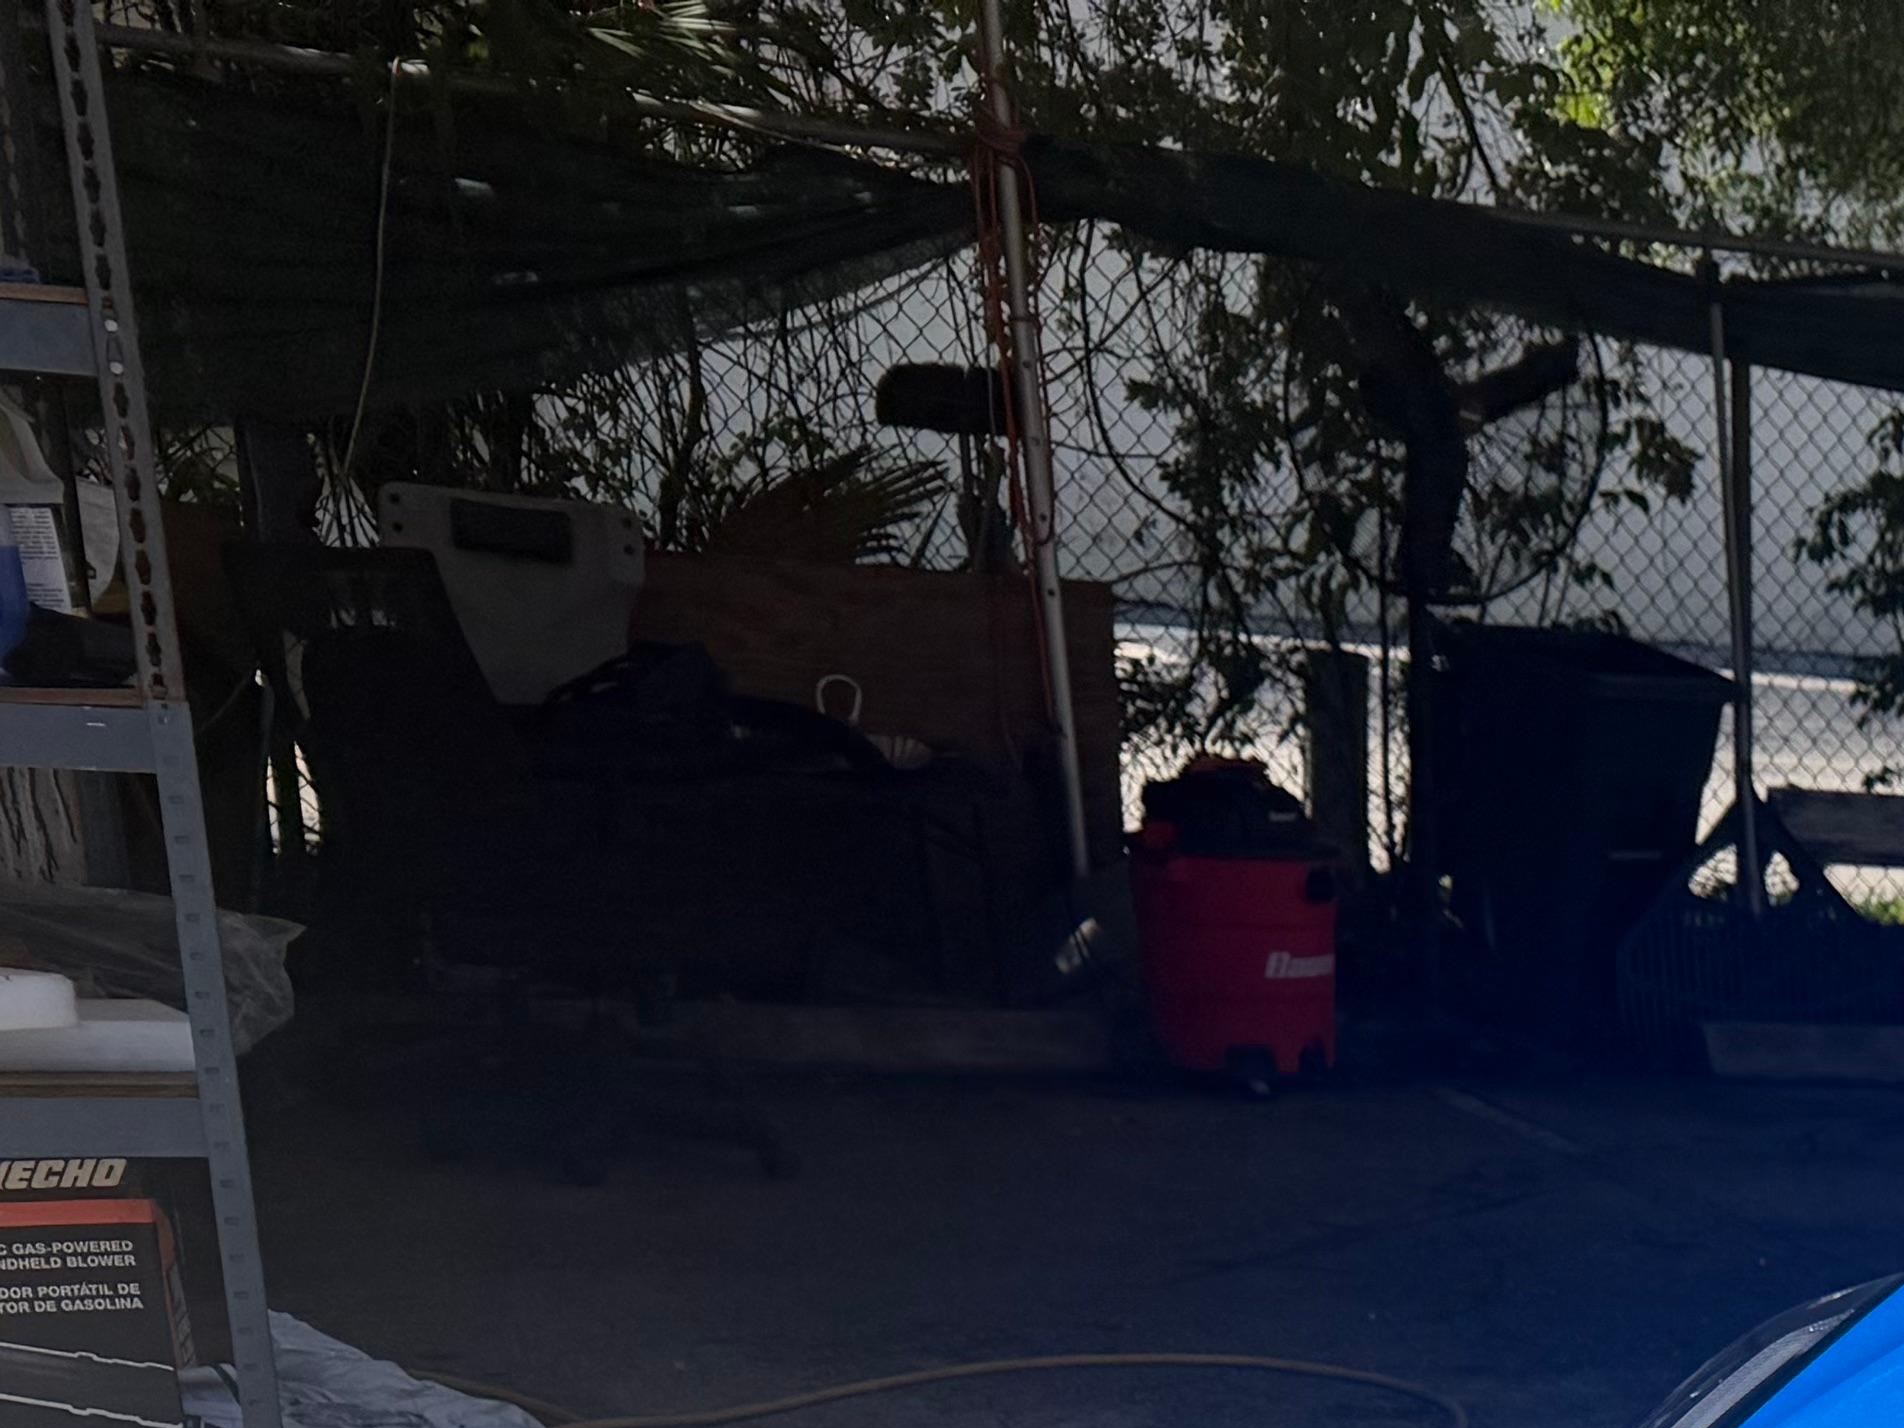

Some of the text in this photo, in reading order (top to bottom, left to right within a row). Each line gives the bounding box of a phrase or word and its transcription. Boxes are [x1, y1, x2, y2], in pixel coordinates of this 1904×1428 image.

[4, 1158, 128, 1189] ECHO
[12, 1240, 133, 1255] GAS-POWERED
[66, 1254, 136, 1268] BLOWER
[37, 1281, 113, 1298] PORTÁTIL
[117, 1283, 141, 1295] DE
[33, 1299, 57, 1313] DE
[61, 1297, 144, 1311] GASOLINA
